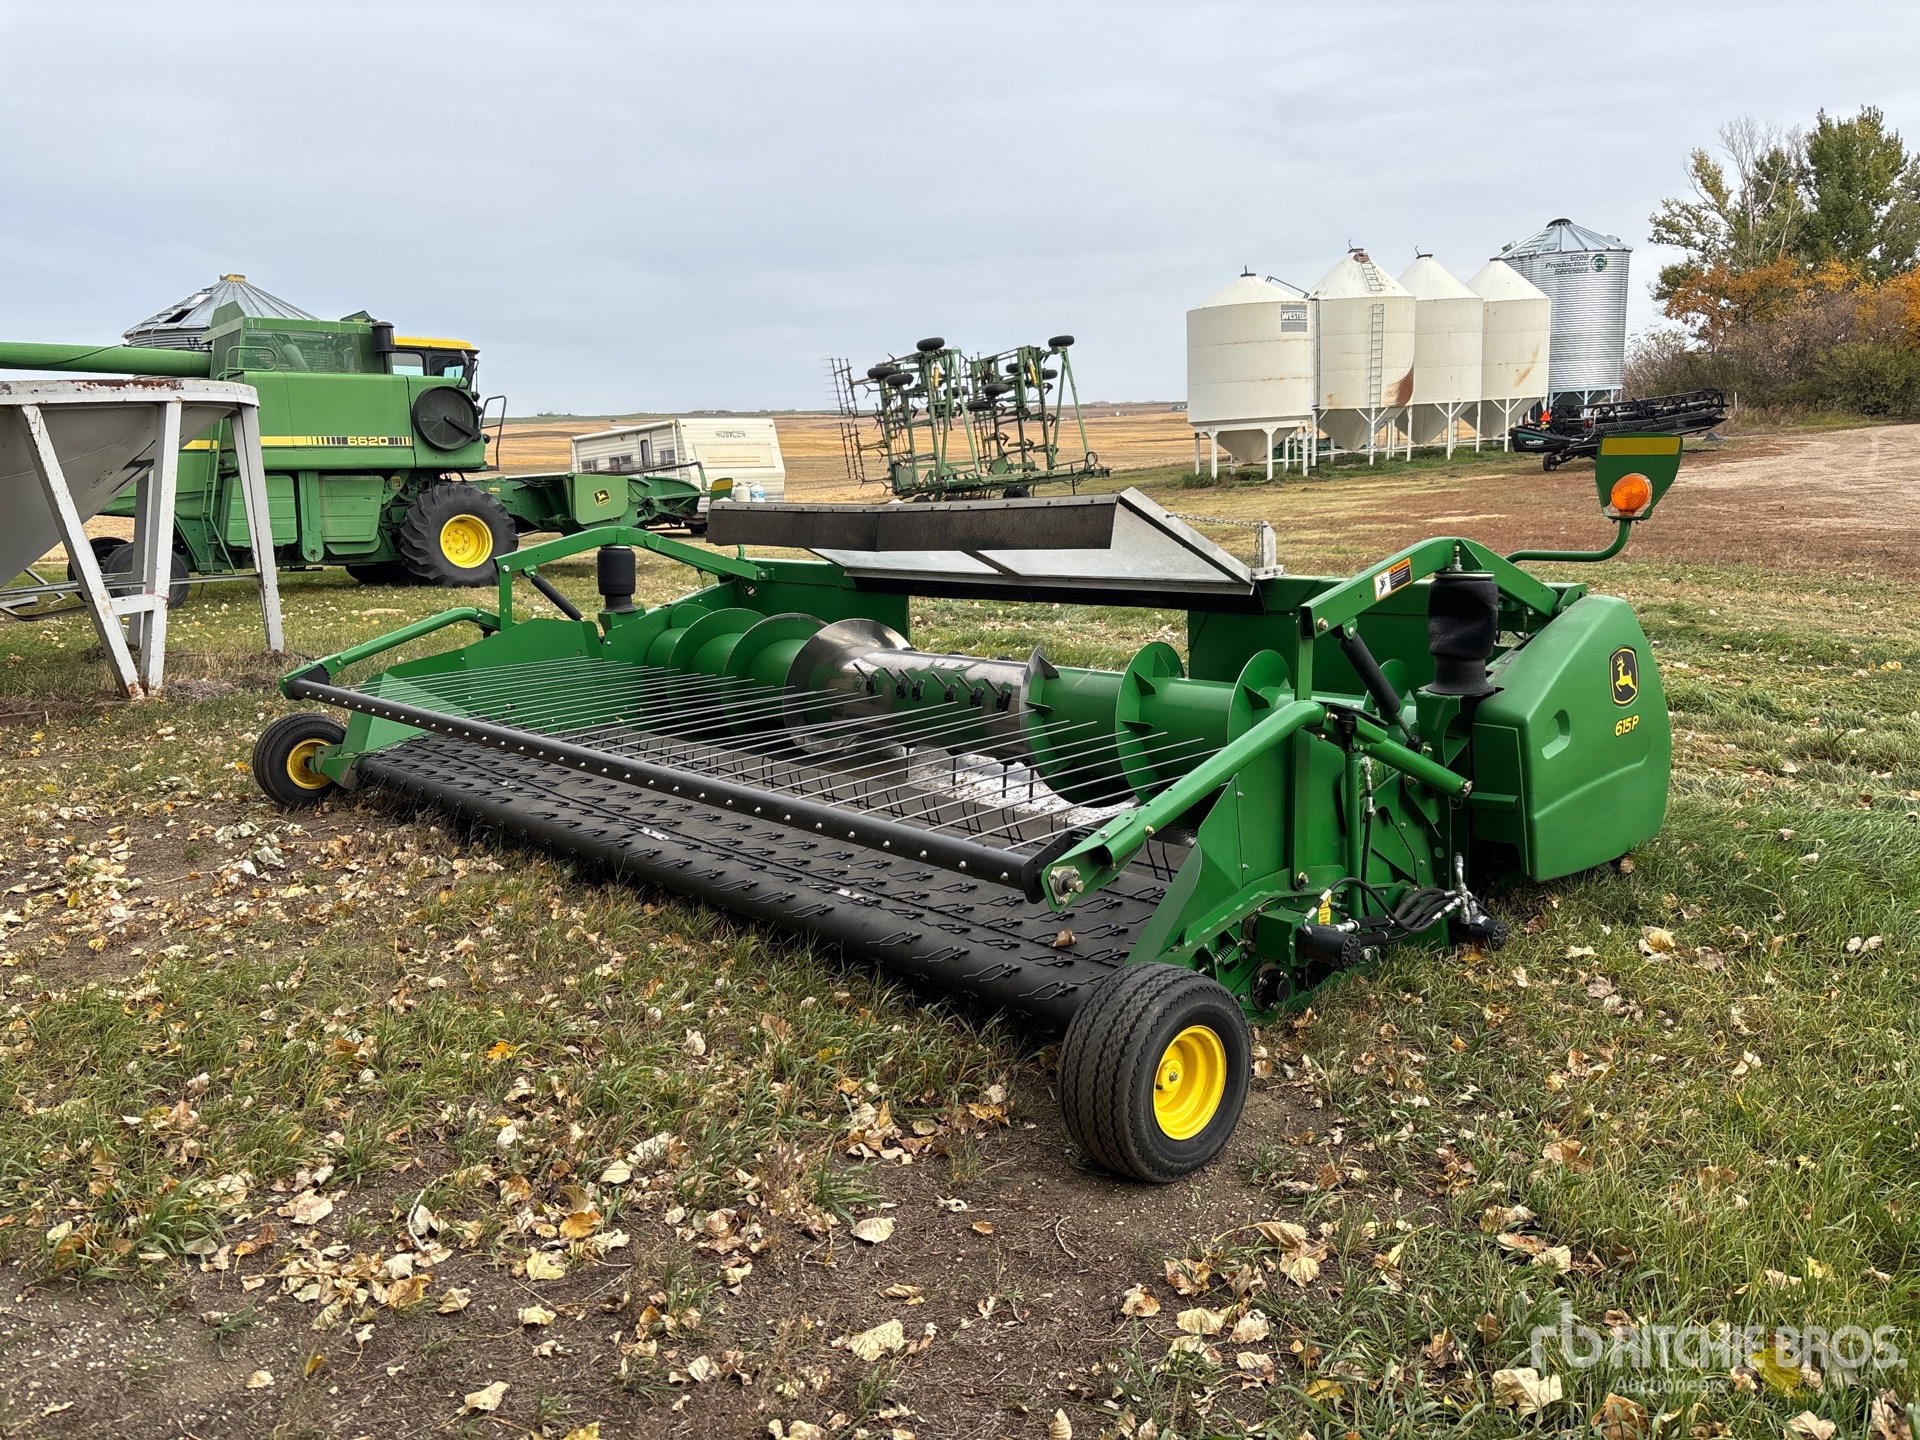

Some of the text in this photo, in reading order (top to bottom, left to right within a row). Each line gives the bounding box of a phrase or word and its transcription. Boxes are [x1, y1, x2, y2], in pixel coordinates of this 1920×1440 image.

[1545, 261, 1589, 269] Production
[1554, 267, 1589, 275] Services
[347, 436, 389, 446] 6620
[1615, 714, 1639, 737] 615P
